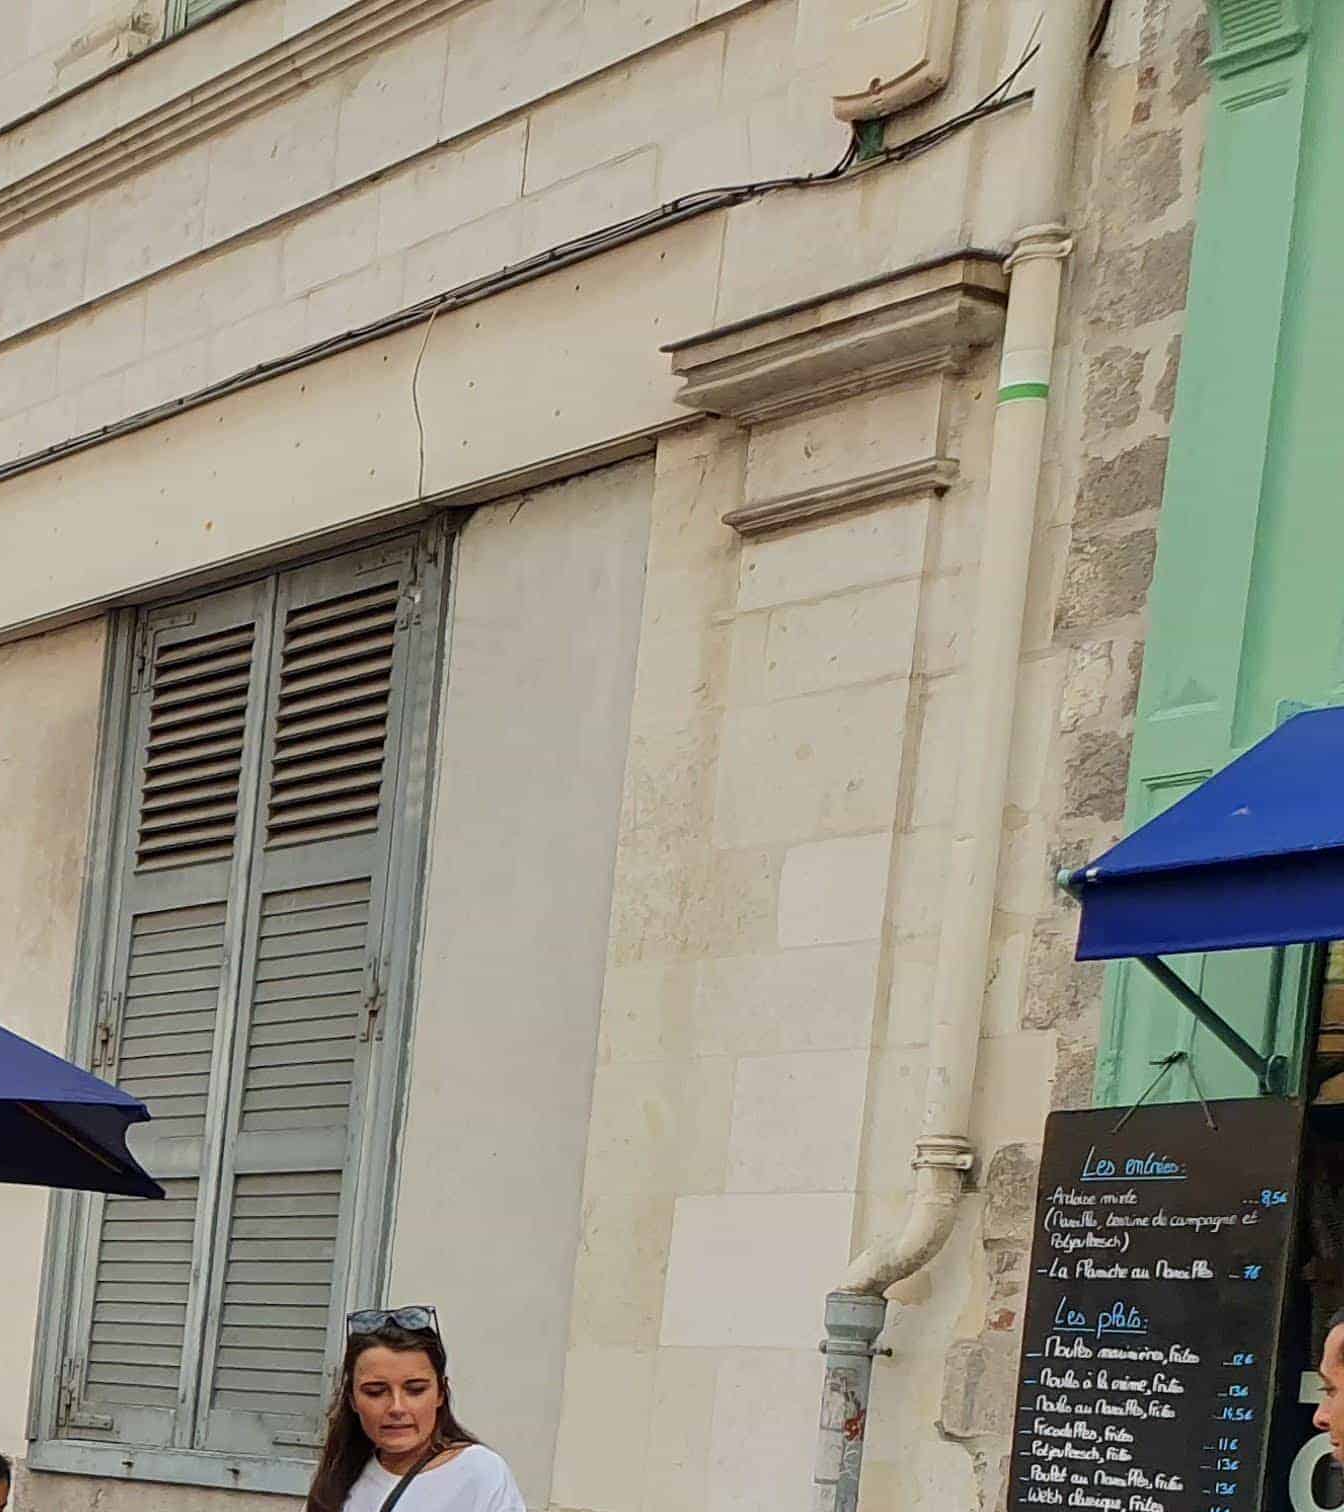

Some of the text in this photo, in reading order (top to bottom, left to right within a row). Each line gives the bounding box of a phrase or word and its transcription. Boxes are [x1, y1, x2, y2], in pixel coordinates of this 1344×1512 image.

[1083, 1146, 1115, 1176] Les
[1151, 1208, 1168, 1227] de
[1169, 1213, 1237, 1232] campagne
[1241, 1209, 1261, 1225] et
[1049, 1256, 1068, 1279] La
[1130, 1266, 1150, 1280] au
[1054, 1296, 1086, 1325] Les
[1045, 1336, 1093, 1359] Moules
[1039, 1367, 1080, 1389] Moules
[1082, 1371, 1093, 1389] à
[1097, 1367, 1109, 1390] la
[1035, 1394, 1073, 1414] Moules
[1074, 1402, 1093, 1414] au
[1030, 1464, 1068, 1483] Poulet
[1070, 1474, 1089, 1486] au
[1216, 1458, 1240, 1471] 13€
[1027, 1487, 1063, 1505] Welsh
